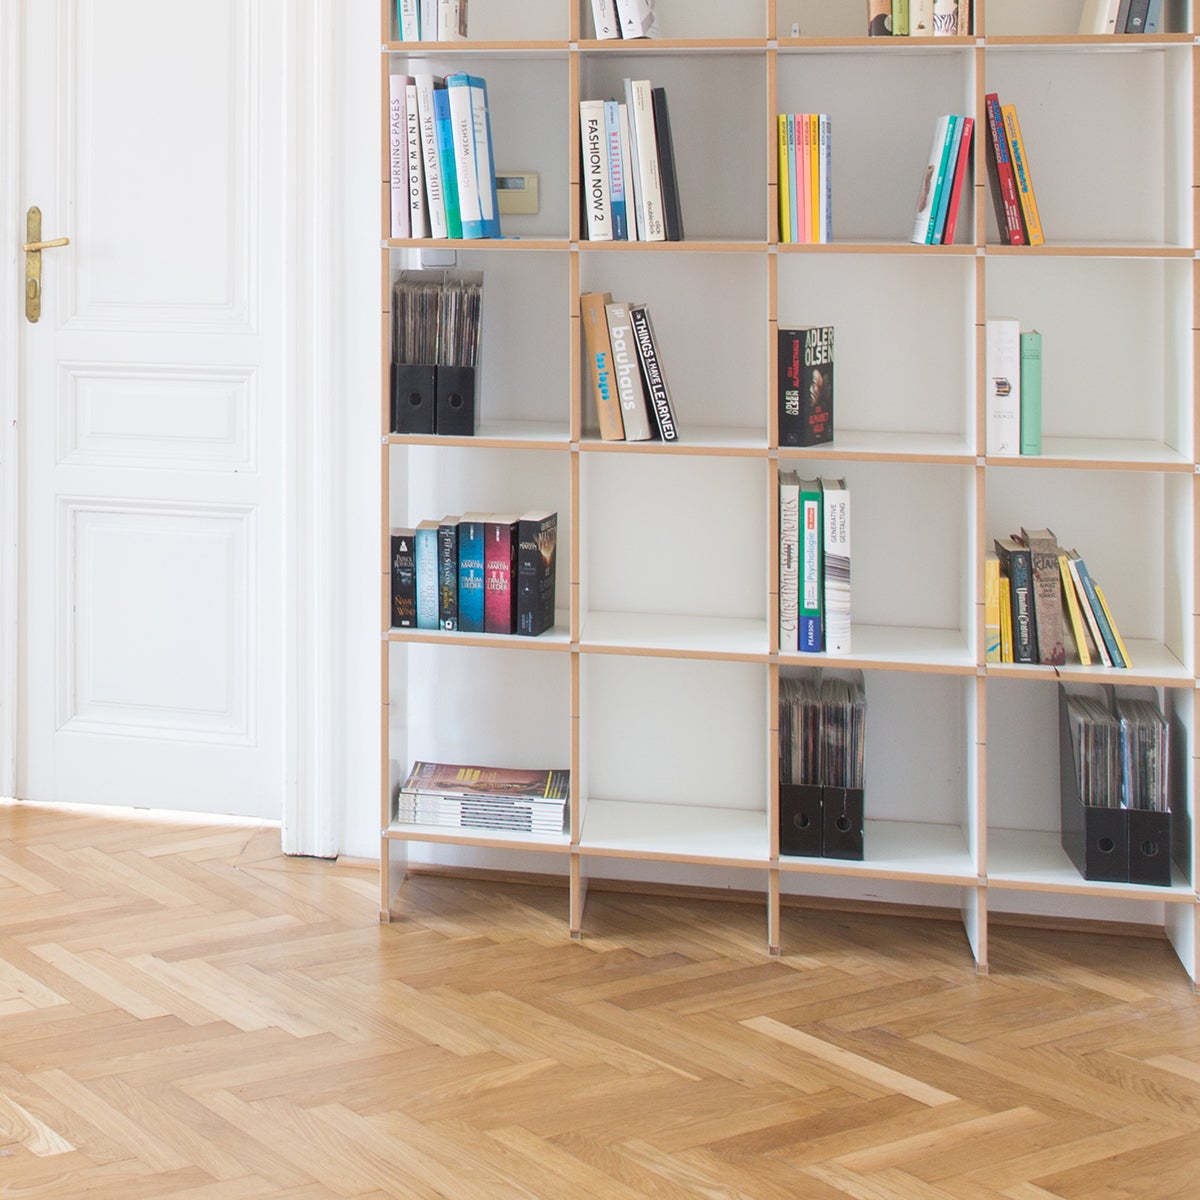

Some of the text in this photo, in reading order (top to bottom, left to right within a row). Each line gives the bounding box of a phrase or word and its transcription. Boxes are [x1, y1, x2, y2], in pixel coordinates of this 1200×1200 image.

[391, 98, 400, 190] TURNING PAGES
[408, 113, 419, 209] MOORMANN
[425, 116, 440, 201] HIDE AND SEEK
[588, 119, 604, 222] FASHION NOW 2
[635, 318, 654, 358] THINGS
[805, 327, 834, 348] ADLER
[805, 344, 834, 366] OLSEN
[596, 352, 610, 401] los logos
[612, 325, 635, 411] bauhaus
[649, 363, 661, 385] HAVE
[652, 384, 675, 440] LEARNED
[791, 390, 799, 416] OLSEN
[807, 533, 816, 580] Psychologie
[1033, 558, 1059, 570] KING
